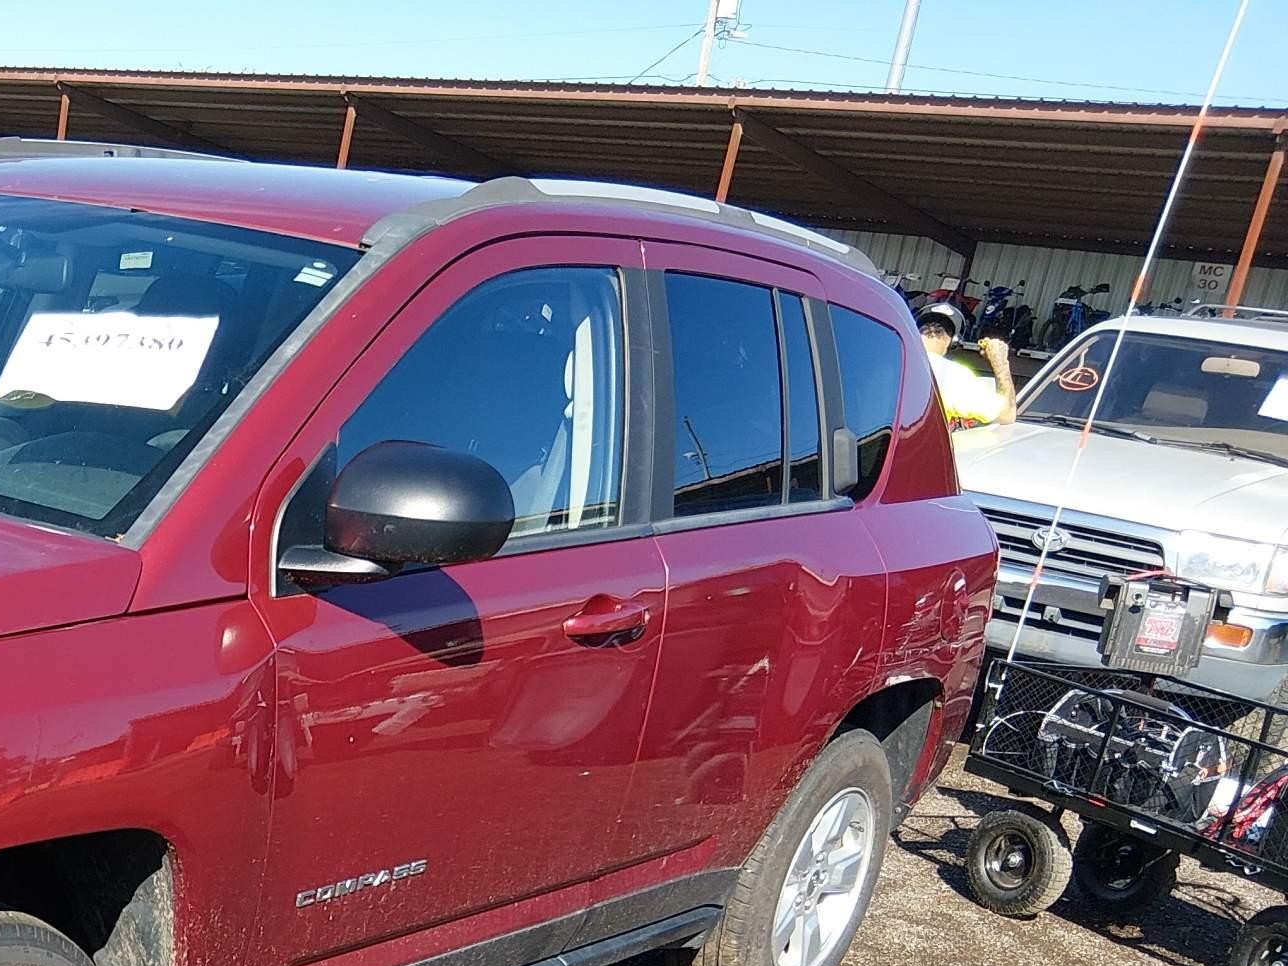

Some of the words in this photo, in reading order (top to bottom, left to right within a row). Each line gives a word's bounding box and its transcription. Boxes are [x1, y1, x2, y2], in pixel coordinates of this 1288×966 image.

[1199, 265, 1224, 277] MC
[1198, 278, 1218, 290] 30
[295, 859, 428, 909] COMPASS
